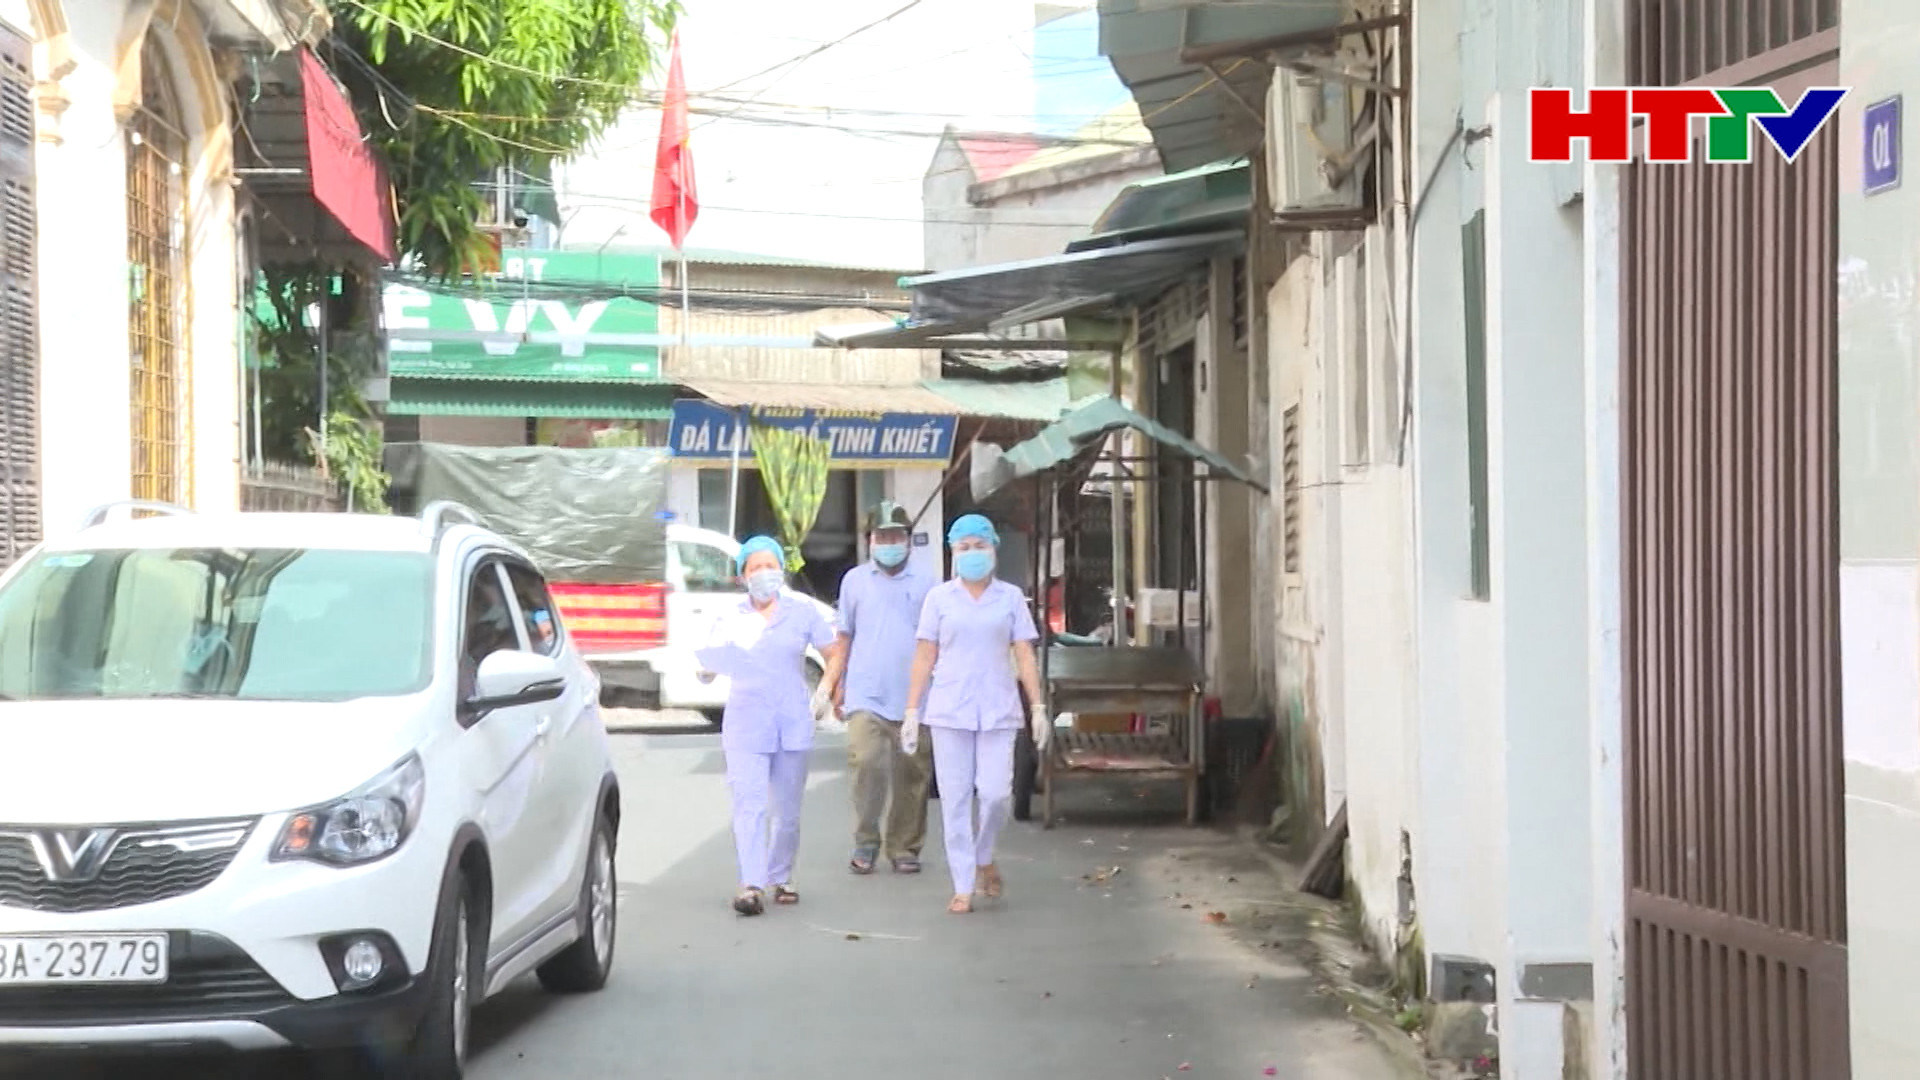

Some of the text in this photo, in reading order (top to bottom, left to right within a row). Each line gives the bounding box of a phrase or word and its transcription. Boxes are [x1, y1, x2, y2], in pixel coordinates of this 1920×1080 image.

[1872, 121, 1891, 171] 01
[462, 298, 611, 357] VY
[828, 426, 877, 453] TINH
[879, 418, 944, 454] KHIẾT
